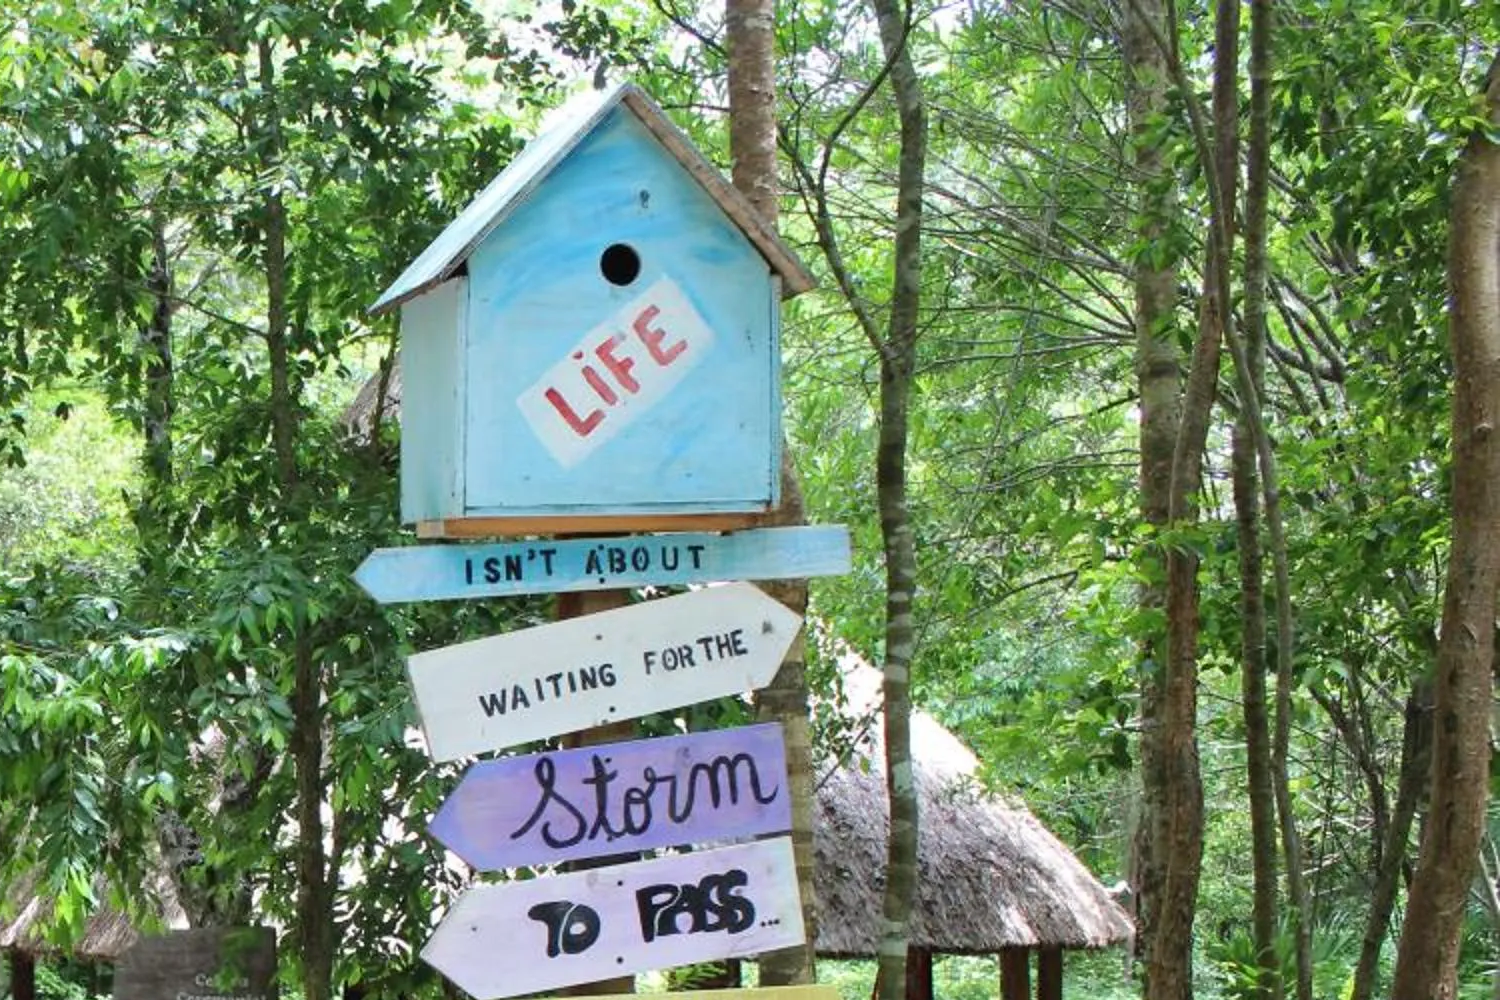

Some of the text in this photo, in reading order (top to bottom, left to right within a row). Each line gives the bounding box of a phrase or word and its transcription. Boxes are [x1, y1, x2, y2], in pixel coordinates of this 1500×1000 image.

[465, 546, 705, 584] ISN'T ABOUT
[479, 629, 748, 718] WAITING FOR THE
[510, 751, 778, 849] Storm
[528, 900, 600, 958] TO
